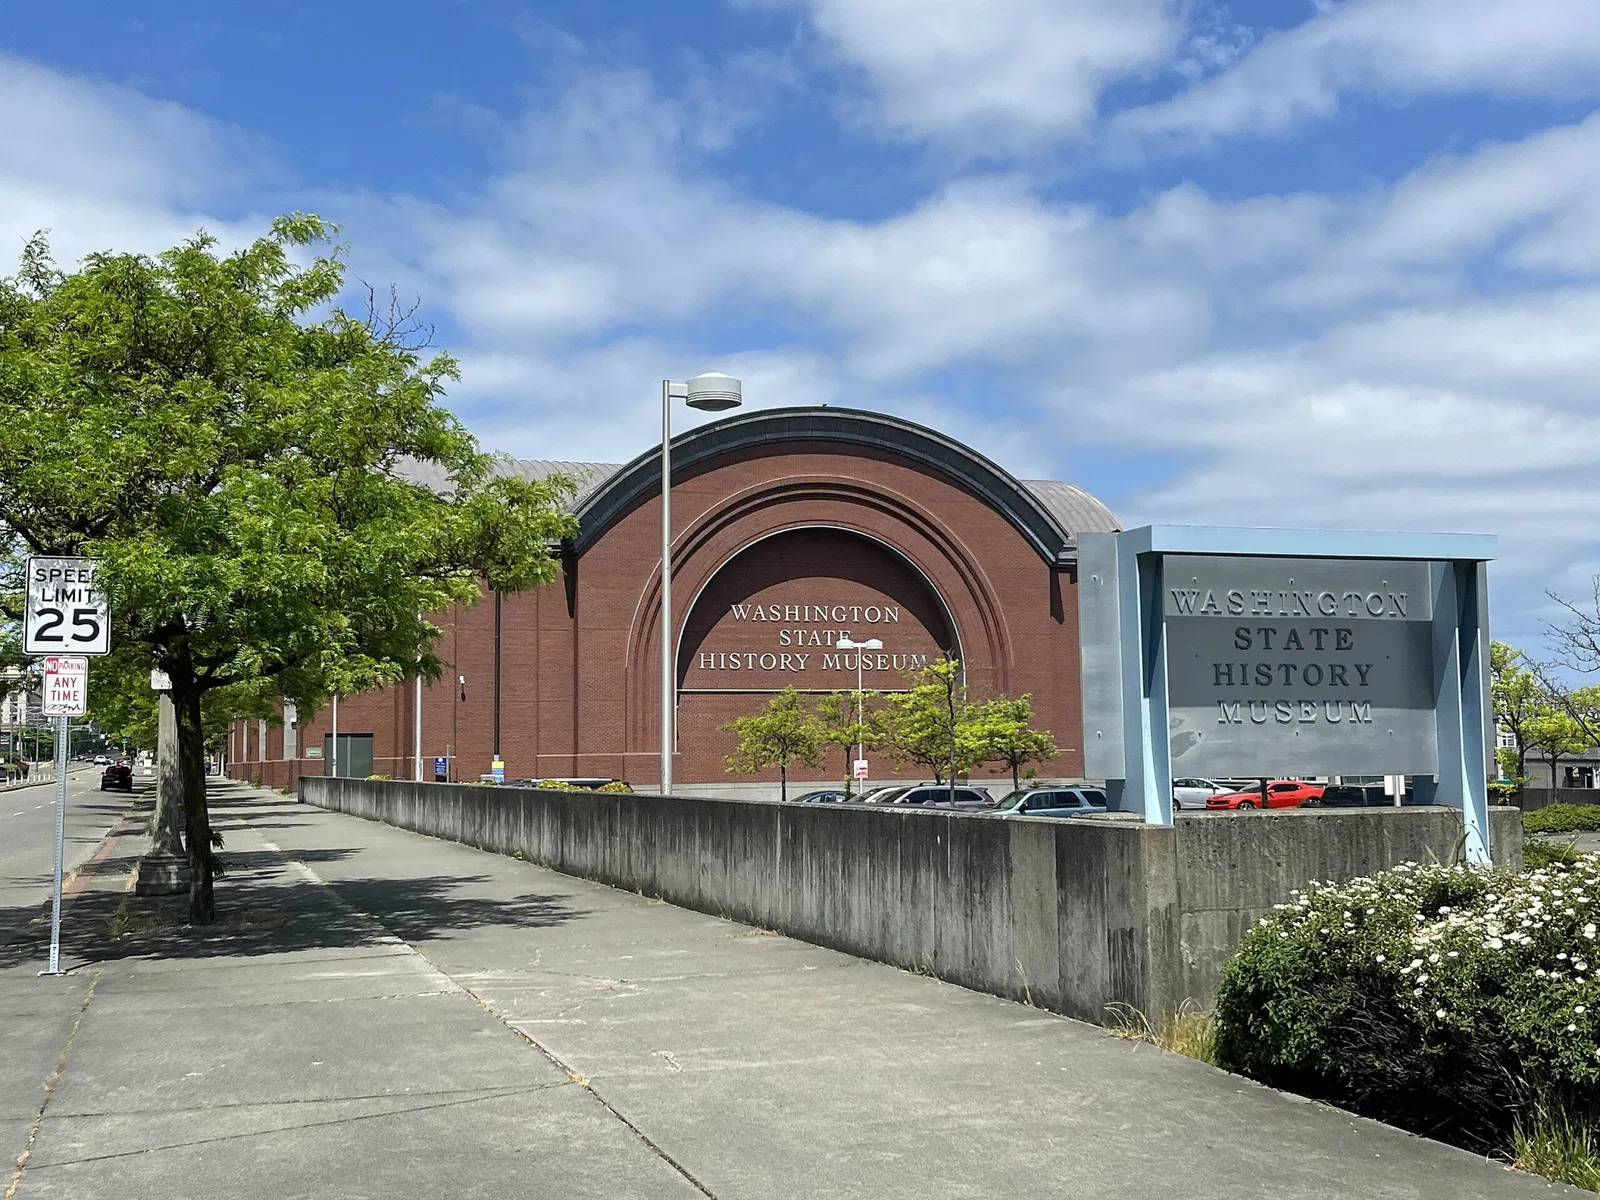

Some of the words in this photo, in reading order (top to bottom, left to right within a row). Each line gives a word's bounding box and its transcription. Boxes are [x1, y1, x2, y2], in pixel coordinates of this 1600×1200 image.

[35, 568, 95, 583] SPEE
[42, 588, 95, 602] LIMIT
[1171, 589, 1408, 617] WASHINGTON
[731, 604, 899, 622] WASHINGTON
[34, 608, 99, 642] 25
[1234, 627, 1354, 650] STATE
[46, 660, 58, 672] NO
[59, 662, 85, 671] PARKING
[699, 653, 810, 672] HISTORY
[821, 653, 927, 671] MUSEUM
[54, 677, 77, 688] ANY
[1213, 663, 1374, 686] HISTORY
[51, 690, 79, 701] TIME
[1218, 700, 1373, 724] MUSEUM
